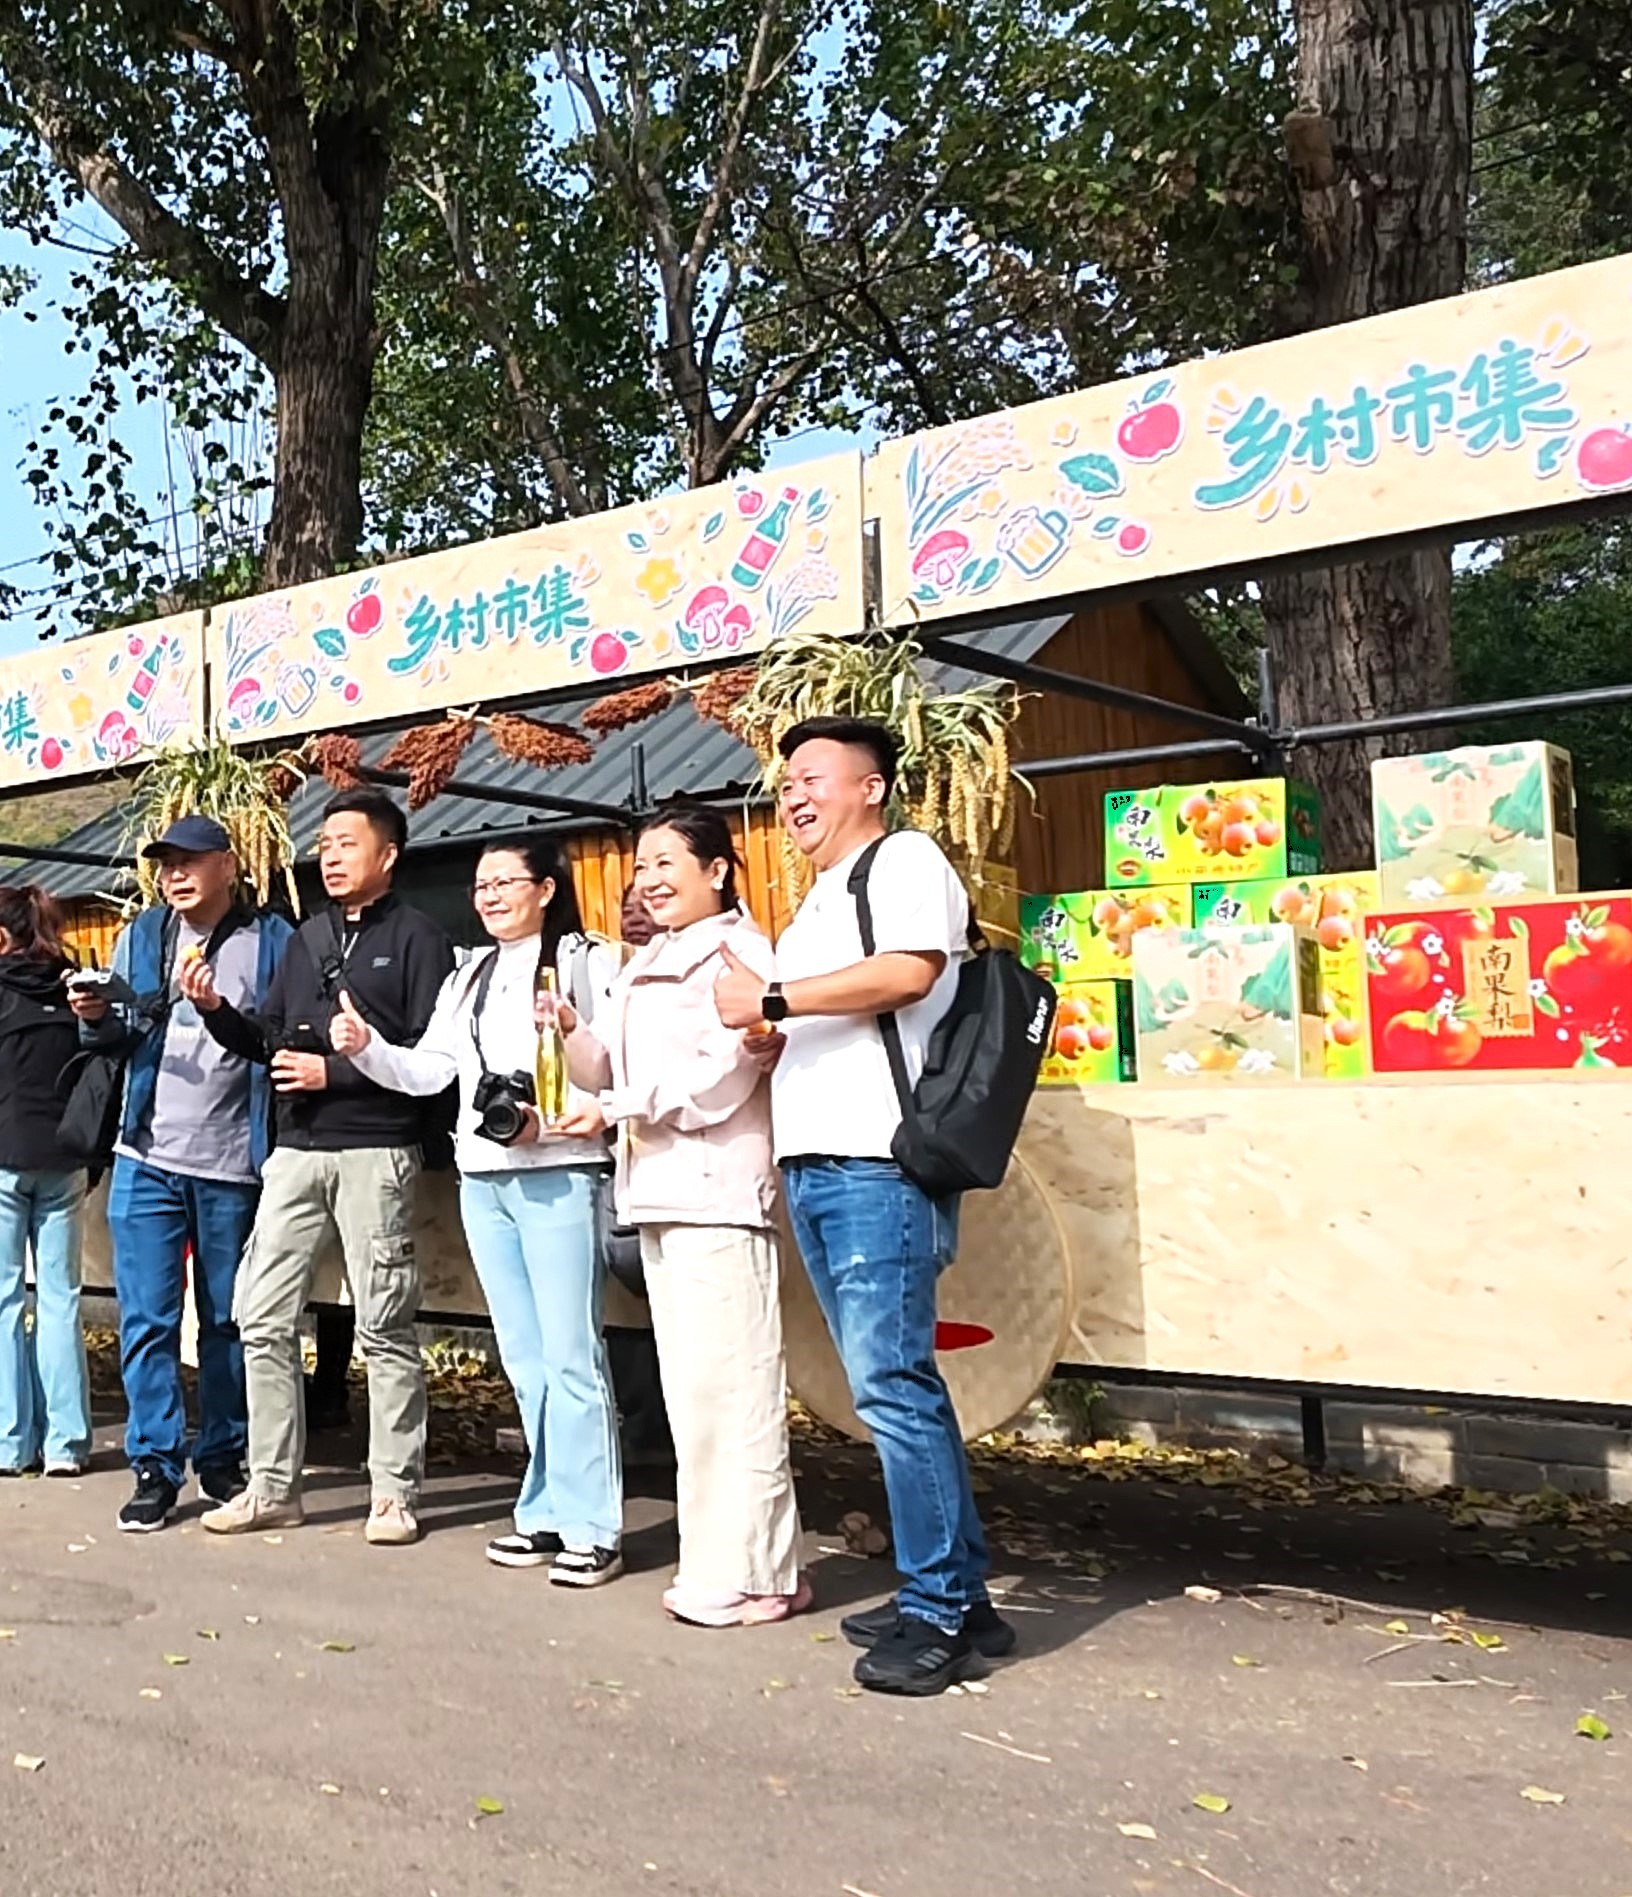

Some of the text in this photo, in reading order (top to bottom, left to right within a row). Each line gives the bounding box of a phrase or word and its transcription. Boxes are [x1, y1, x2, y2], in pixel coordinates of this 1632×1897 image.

[1194, 339, 1574, 505] 乡村市集
[387, 564, 590, 672] 乡村市集
[1480, 945, 1516, 1030] 南果梨
